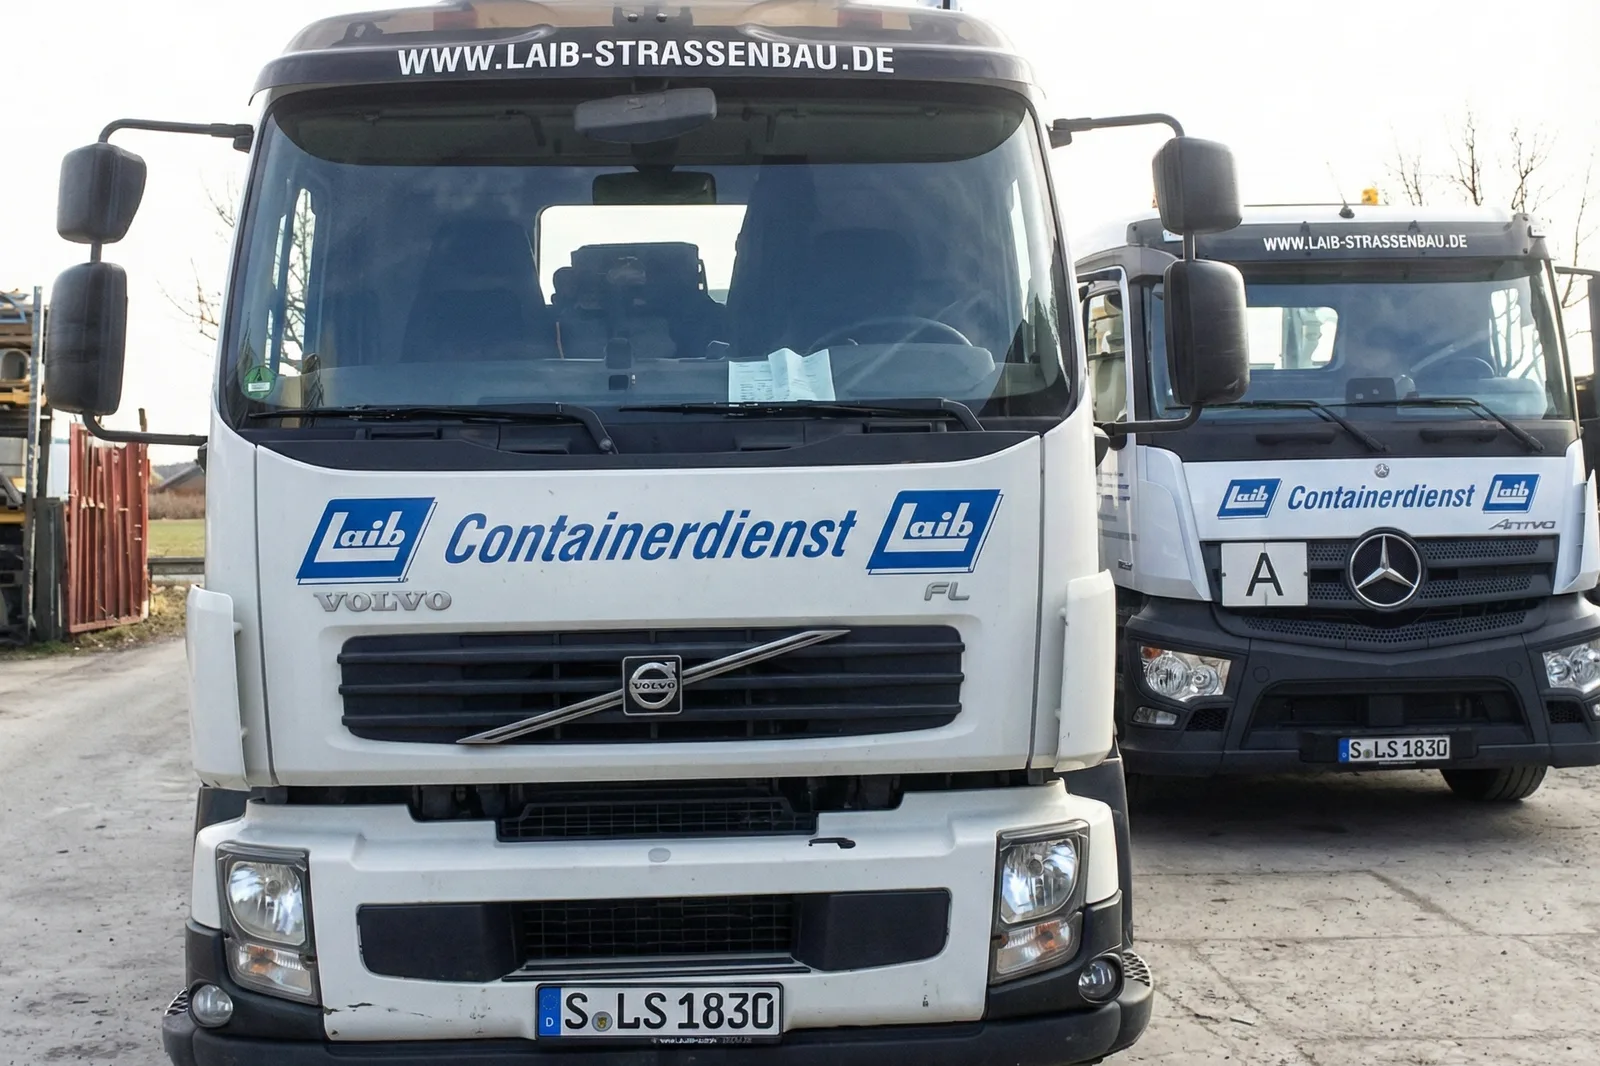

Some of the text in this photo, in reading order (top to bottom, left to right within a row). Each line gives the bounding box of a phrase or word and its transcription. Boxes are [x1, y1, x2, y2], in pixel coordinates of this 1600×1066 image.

[398, 40, 895, 76] WWW.LAIB-STRASSENBAU.DE
[1263, 234, 1468, 251] WWW.LAIB-STRASSENBAU.DE
[1224, 485, 1269, 510] Laib
[1287, 483, 1476, 510] Containerdienst
[1488, 480, 1530, 505] Laib
[313, 510, 406, 564] Laib
[444, 509, 858, 564] Containerdienst
[883, 502, 974, 553] Laib
[1245, 552, 1284, 597] A
[313, 590, 453, 613] VOLVO
[923, 581, 971, 601] FL
[632, 682, 676, 690] VOLVO
[545, 1017, 554, 1028] D
[564, 992, 589, 1030] S
[677, 991, 774, 1030] 1830
